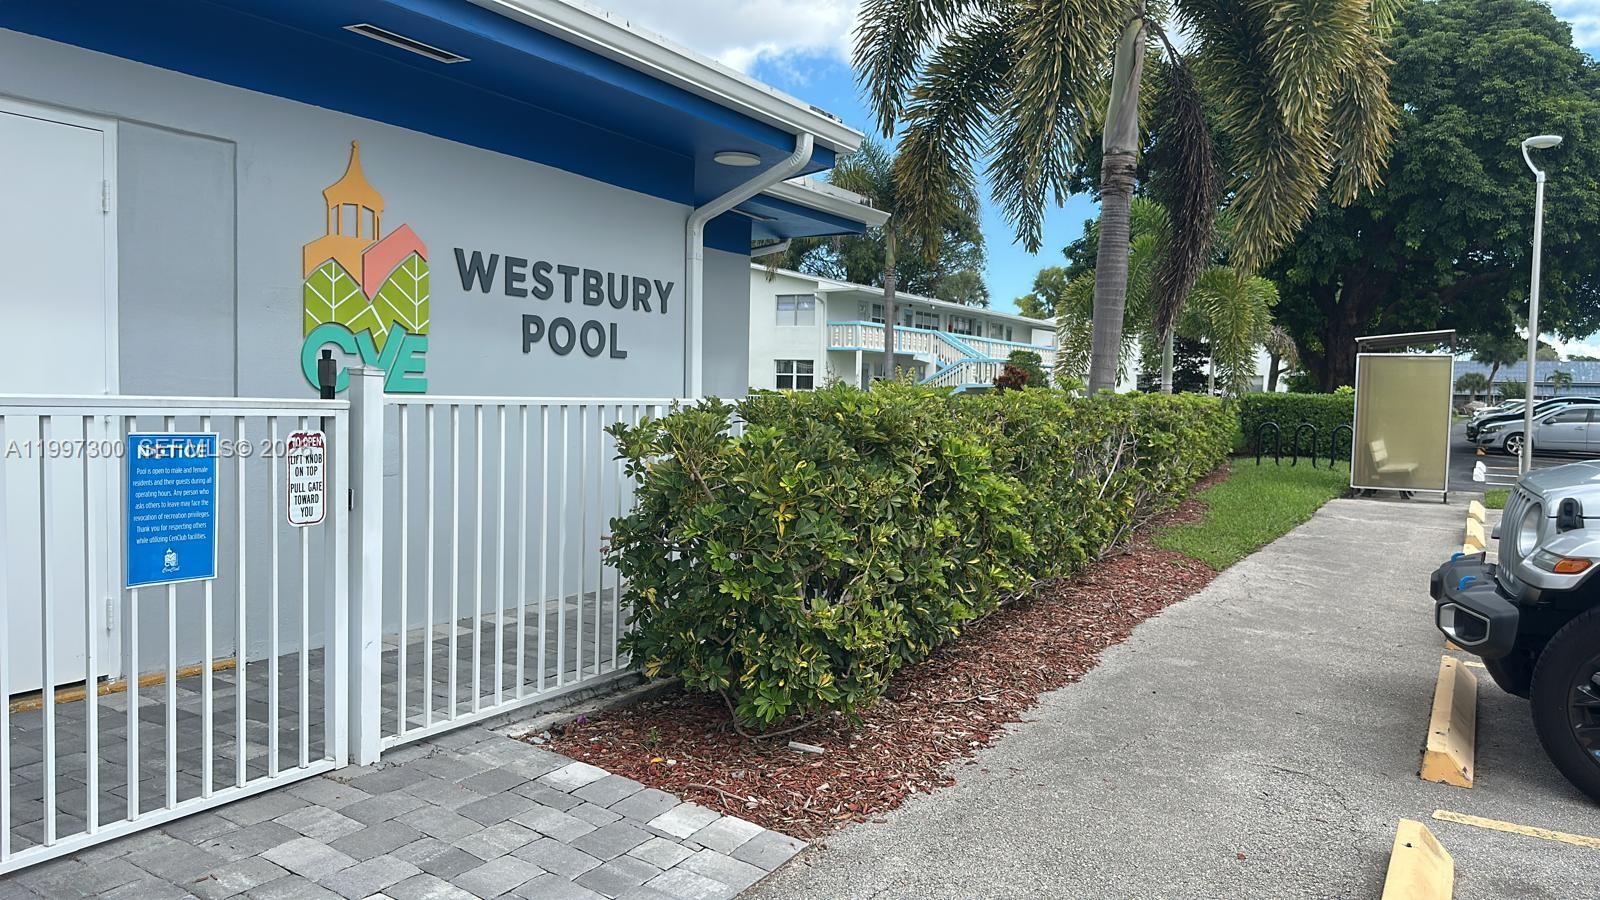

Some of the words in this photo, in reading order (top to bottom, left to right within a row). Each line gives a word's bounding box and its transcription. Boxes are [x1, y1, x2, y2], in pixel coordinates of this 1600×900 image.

[454, 247, 675, 314] WESTBURY
[522, 314, 628, 359] POOL
[301, 320, 429, 394] CVE
[303, 436, 322, 447] OPEN
[290, 454, 303, 465] LIFT
[306, 453, 322, 464] KNOB
[295, 466, 304, 477] ON
[306, 465, 318, 476] TOP
[290, 483, 305, 494] PULL
[308, 481, 322, 492] GATE
[135, 490, 157, 498] operating
[294, 494, 319, 505] TOWARD
[300, 506, 314, 518] YOU
